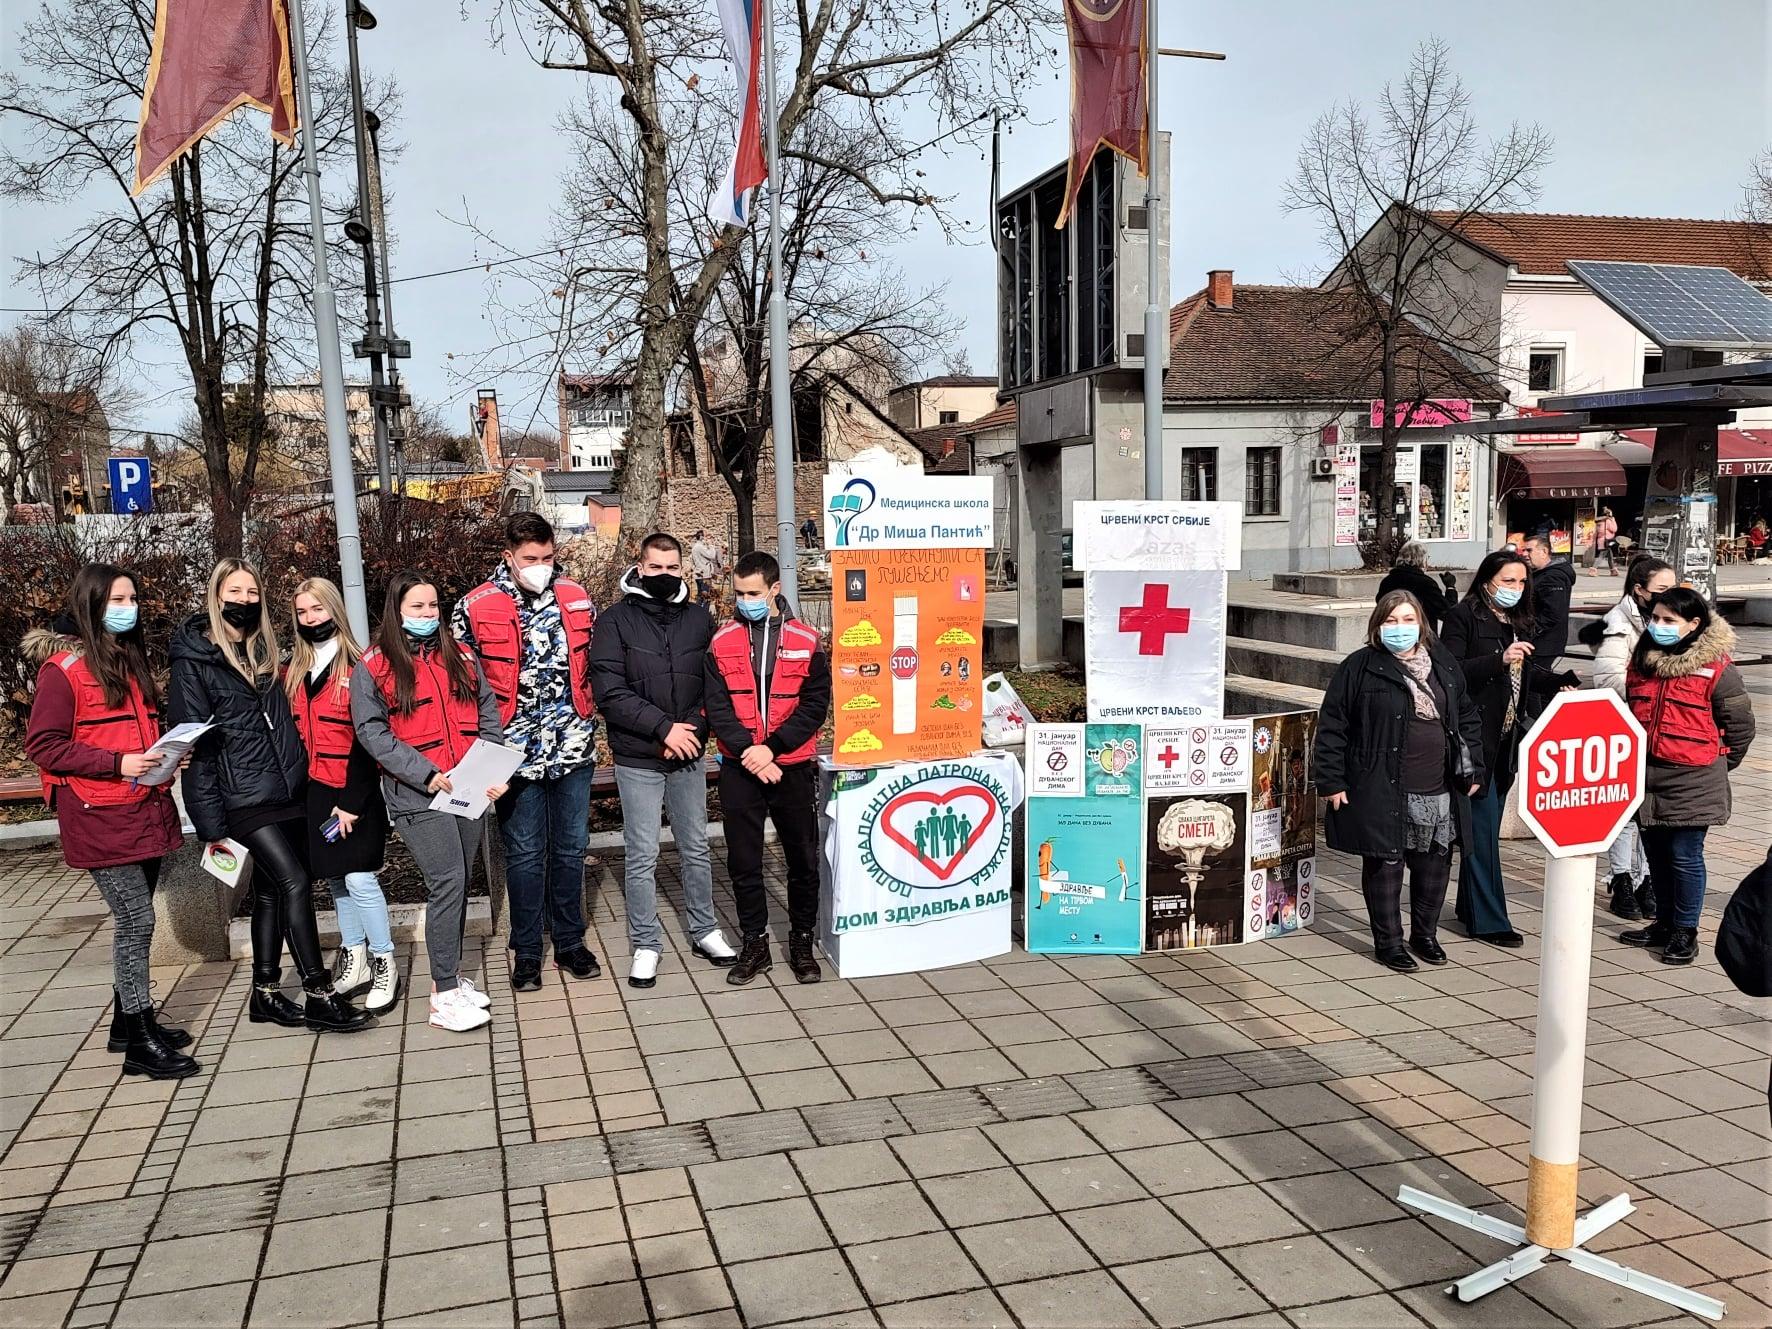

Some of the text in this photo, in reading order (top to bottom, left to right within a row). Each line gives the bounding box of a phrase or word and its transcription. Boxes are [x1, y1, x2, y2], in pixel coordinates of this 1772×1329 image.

[119, 461, 141, 493] P
[880, 497, 989, 510] Медицинска школа
[1101, 514, 1211, 526] ЦРВЕНИ КРСТ СРБИЈЕ
[884, 525, 926, 539] Миша
[891, 656, 917, 670] STOP
[1100, 706, 1202, 717] ЦРВЕНИ КРСТ ВАЉЕВО
[1051, 732, 1076, 741] јануар
[1536, 734, 1632, 788] STOP
[1535, 783, 1630, 812] CIGARETAMA
[858, 764, 1012, 898] ПОЛИВАЛЕНТНА ПАТРОНАЖНА СЛУЖБА
[1178, 822, 1216, 839] СМЕТА
[1059, 882, 1093, 895] ЗДРАВЉЕ
[1059, 897, 1070, 905] НА
[835, 911, 878, 932] ДОМ
[884, 897, 971, 924] ЗДРАВЉА
[1059, 906, 1081, 915] МЕСТУ
